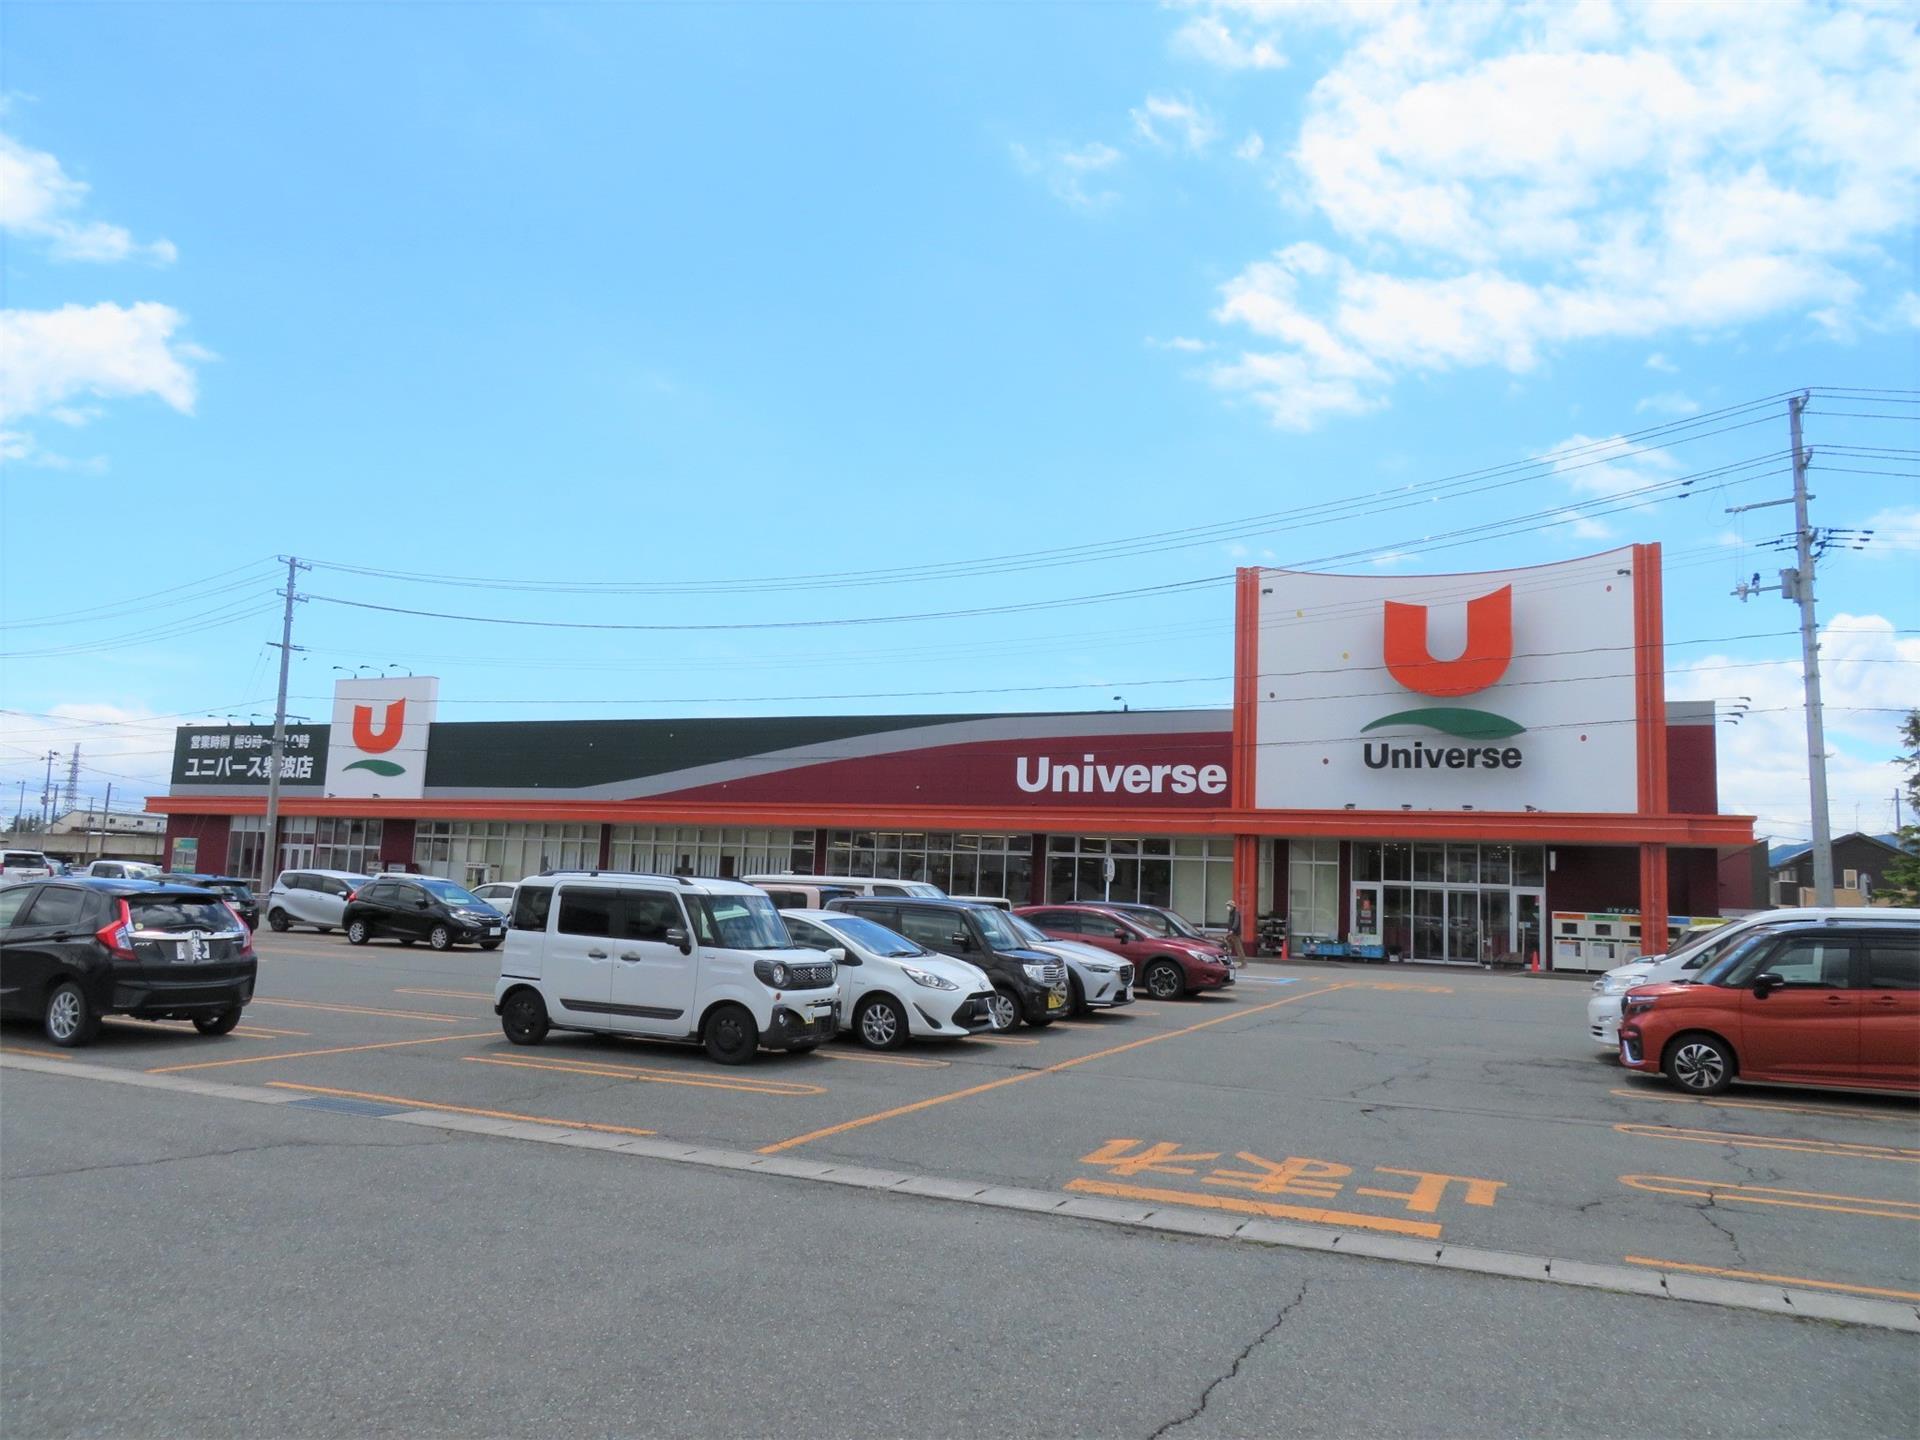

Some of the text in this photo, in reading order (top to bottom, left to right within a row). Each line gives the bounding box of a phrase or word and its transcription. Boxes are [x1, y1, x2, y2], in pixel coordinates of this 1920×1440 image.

[1384, 583, 1513, 697] U
[190, 735, 231, 750] 営業時間
[1363, 742, 1522, 770] Universe
[1016, 754, 1227, 794] Universe
